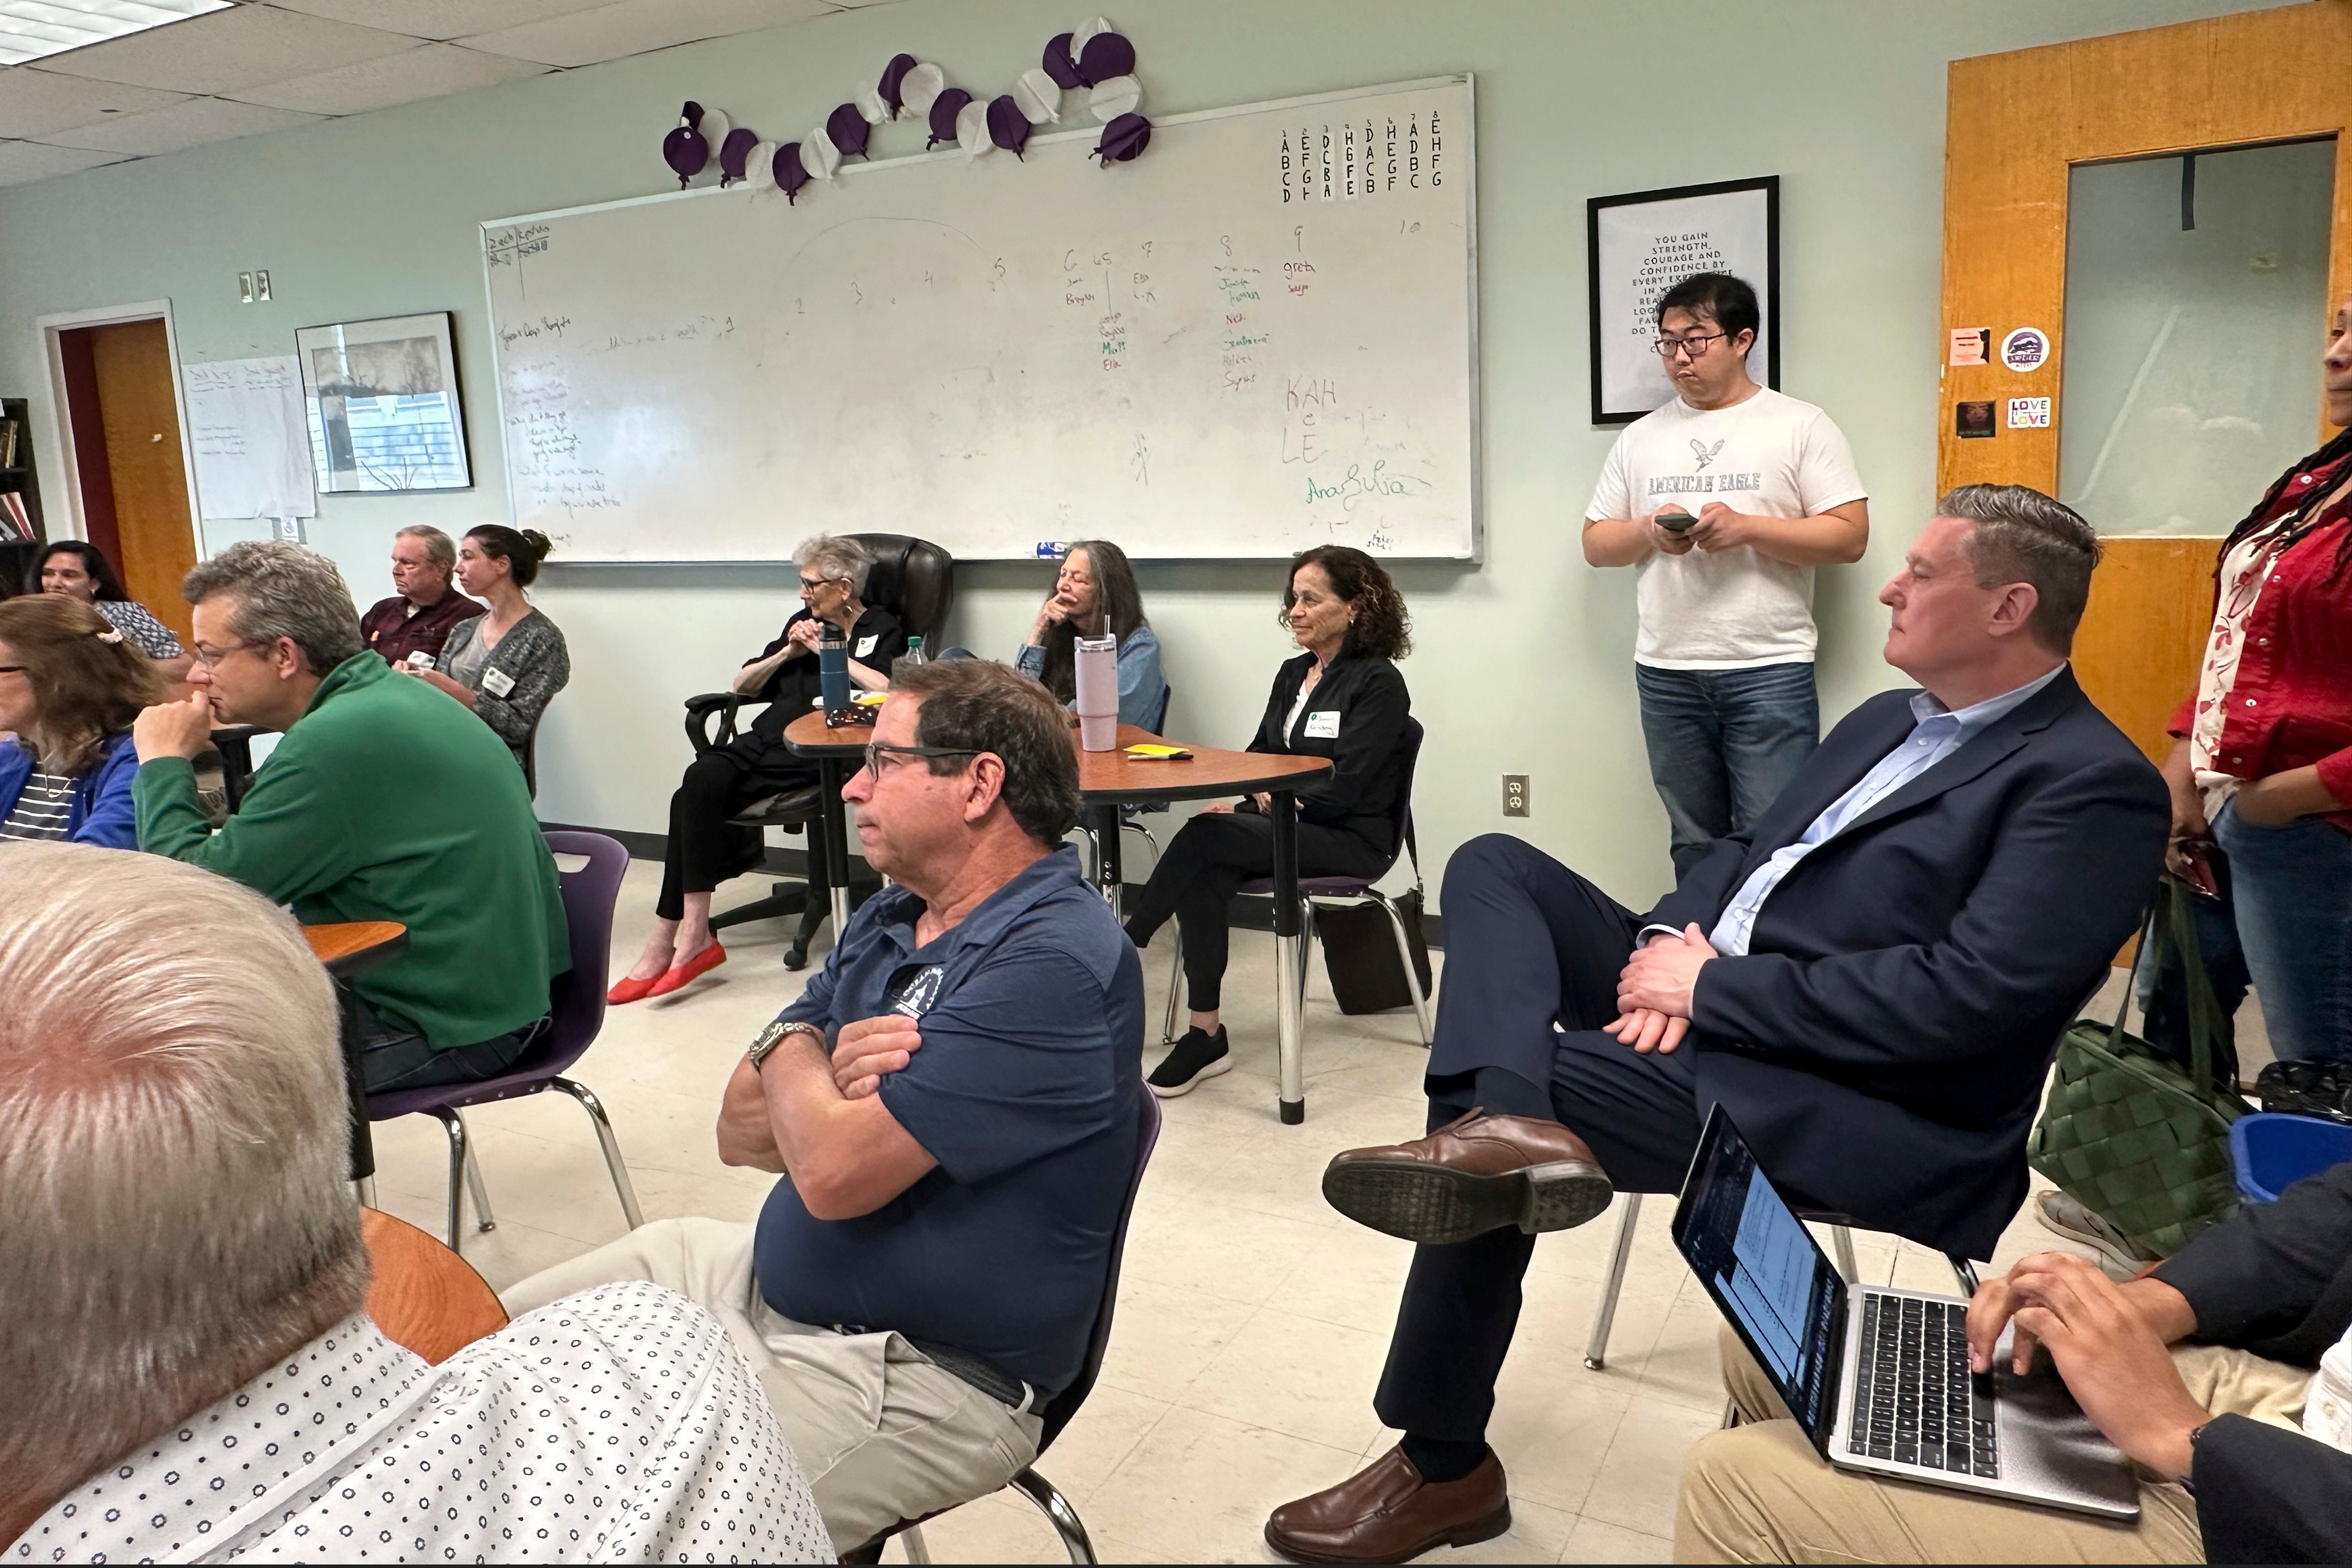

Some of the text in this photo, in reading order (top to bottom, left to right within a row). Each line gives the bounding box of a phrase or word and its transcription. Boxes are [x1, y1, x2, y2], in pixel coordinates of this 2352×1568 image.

[1281, 119, 1440, 153] A E D H D H A E
[1281, 136, 1441, 170] B F C G A E D H
[1282, 154, 1441, 186] C G B F C G B F
[1283, 189, 1290, 203] D
[1324, 184, 1331, 198] A
[1347, 180, 1354, 195] E
[1366, 179, 1375, 193] B
[1388, 176, 1397, 191] F
[1410, 174, 1419, 189] C
[1432, 171, 1441, 186] G
[1655, 232, 1708, 244] YOU GAIN
[1653, 242, 1711, 255] STRENGTH,
[1644, 251, 1720, 265] COURAGE AND
[1640, 262, 1708, 275] CONFIDENCE
[1632, 276, 1664, 286] EVERY
[2012, 400, 2047, 410] LOVE
[2011, 415, 2047, 425] LOVE
[1648, 473, 1761, 495] AMERICAN EAGLE
